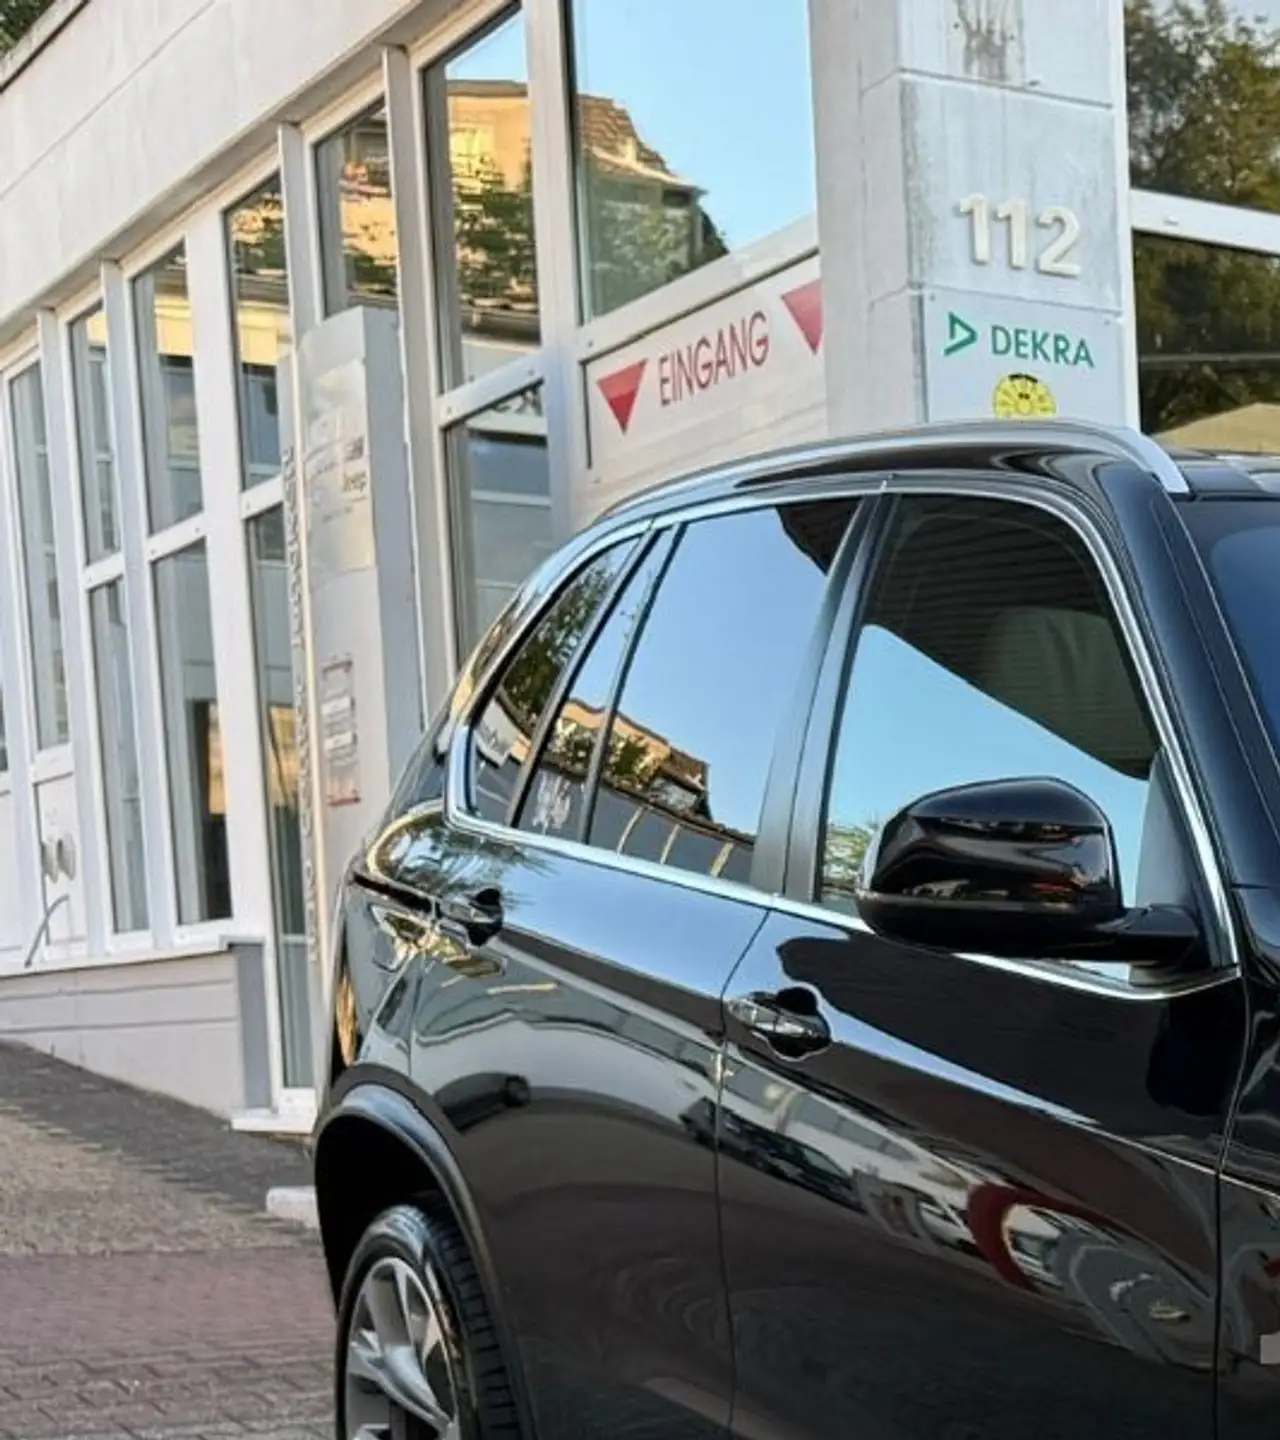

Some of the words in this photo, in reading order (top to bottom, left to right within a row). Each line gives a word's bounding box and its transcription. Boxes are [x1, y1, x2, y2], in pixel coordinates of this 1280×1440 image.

[955, 191, 1083, 279] 112
[657, 310, 770, 407] EINGANG
[990, 323, 1096, 369] DEKRA
